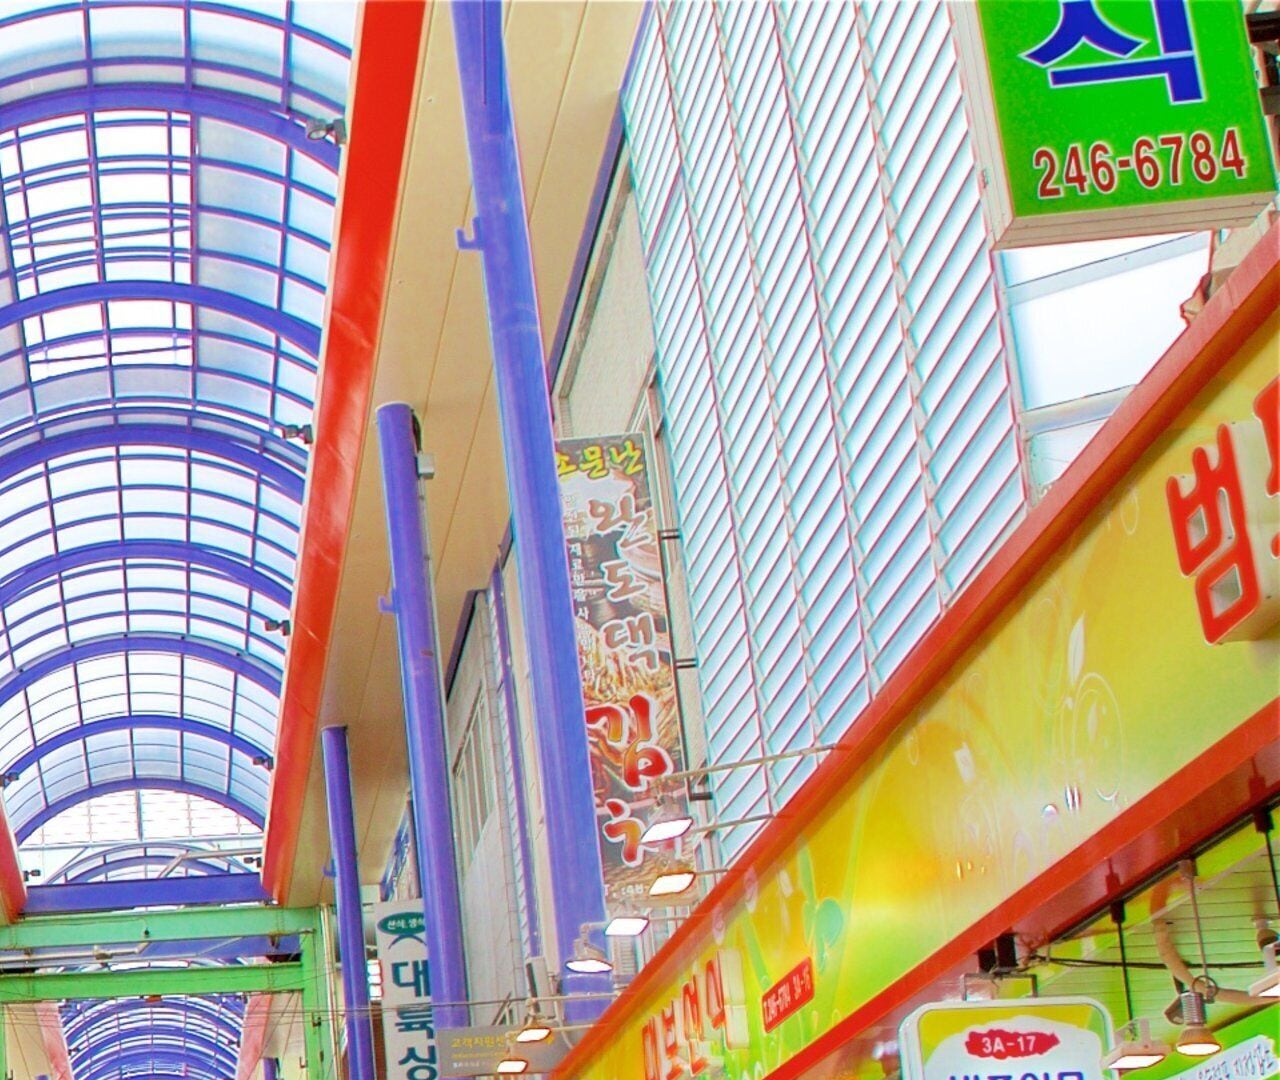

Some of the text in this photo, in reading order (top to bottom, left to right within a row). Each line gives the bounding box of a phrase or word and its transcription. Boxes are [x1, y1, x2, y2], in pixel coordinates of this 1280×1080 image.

[1034, 127, 1247, 198] 246-6784
[1166, 375, 1280, 645] 범
[982, 1035, 1036, 1054] 3A-17
